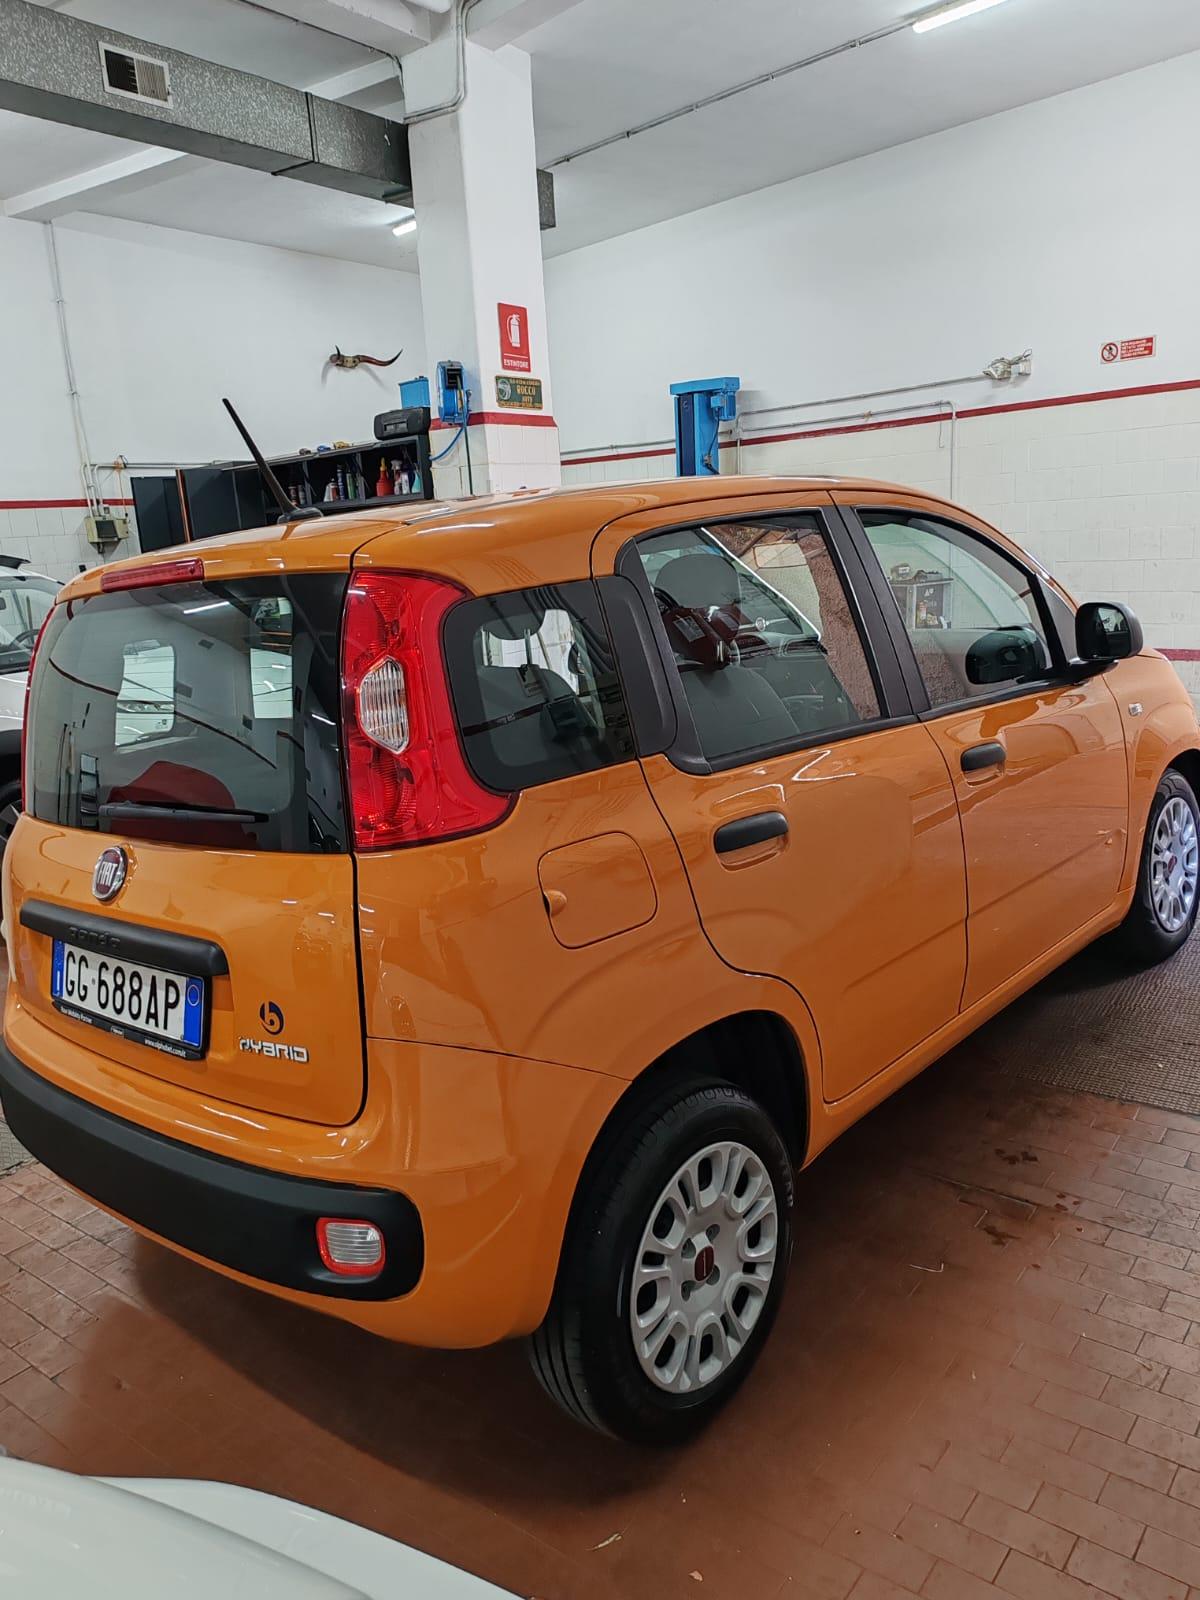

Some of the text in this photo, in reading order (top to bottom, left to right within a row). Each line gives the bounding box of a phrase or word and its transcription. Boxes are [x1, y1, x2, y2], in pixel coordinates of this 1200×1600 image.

[503, 358, 529, 368] ESTINTORE
[97, 861, 118, 886] FIAT
[97, 961, 181, 1031] 688AP
[239, 1036, 308, 1062] HYBRID
